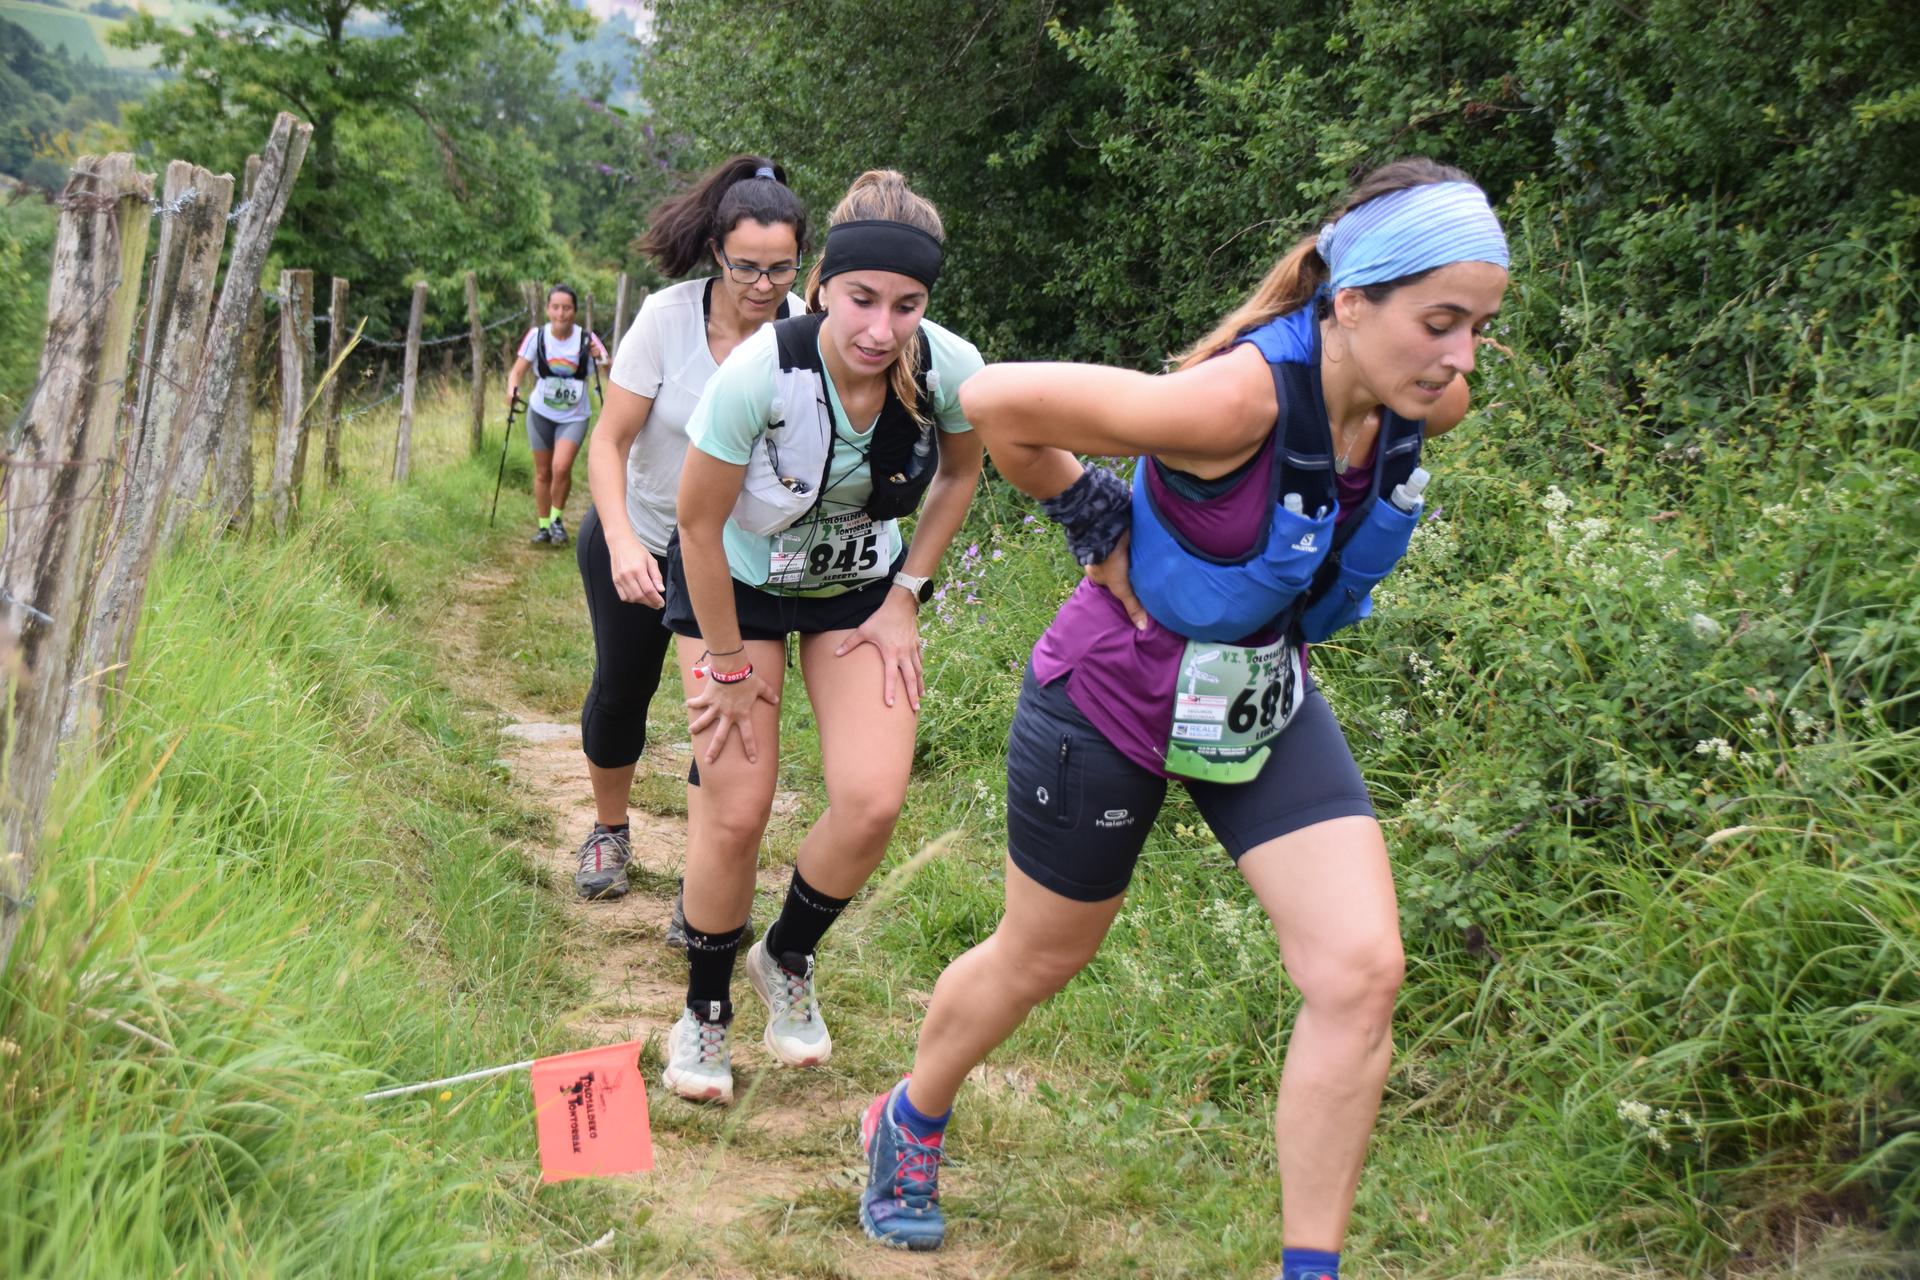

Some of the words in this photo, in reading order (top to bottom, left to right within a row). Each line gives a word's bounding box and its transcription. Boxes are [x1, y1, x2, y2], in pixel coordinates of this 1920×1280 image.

[821, 525, 833, 541] 2
[809, 534, 879, 576] 845
[823, 572, 857, 580] ALBERTO
[1247, 664, 1261, 685] 2
[580, 1071, 598, 1139] TOLOSALDEKO
